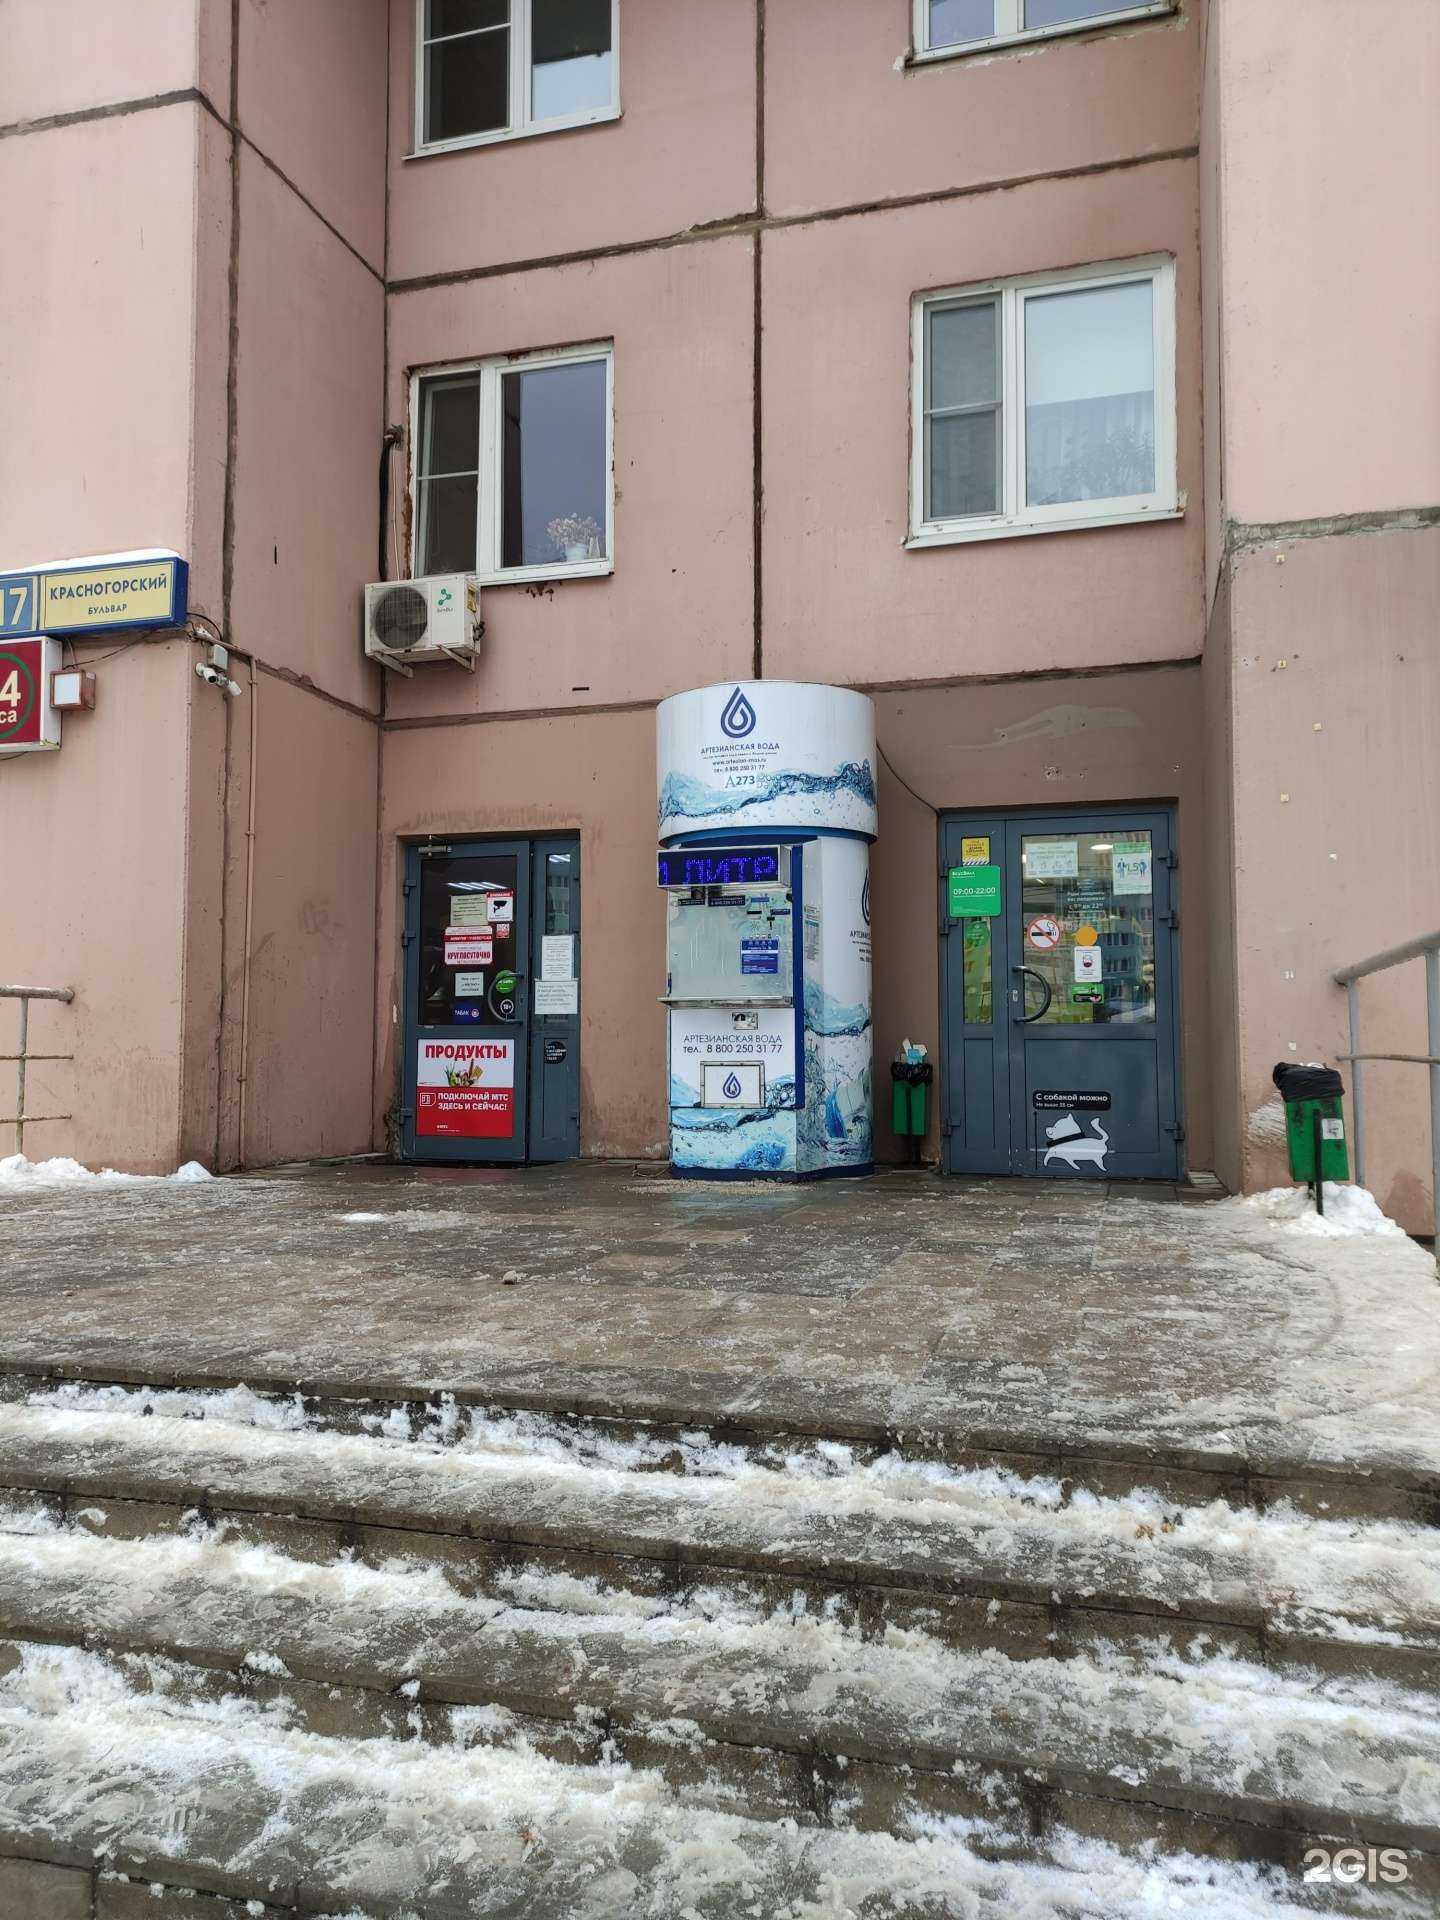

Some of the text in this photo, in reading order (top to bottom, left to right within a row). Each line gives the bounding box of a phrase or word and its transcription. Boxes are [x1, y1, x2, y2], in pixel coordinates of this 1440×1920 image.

[50, 573, 167, 601] КРАСНОГОРСКИЙ
[88, 603, 128, 615] БУЛЬВАР
[700, 742, 780, 754] АРТЕЗИАНСКАЯ ВОДА
[447, 951, 491, 960] КРУГЛОСУТОЧНО
[683, 1034, 782, 1043] АРТЕЗИАНСКАЯ ВОДА
[425, 1044, 507, 1061] ПРОДУКТЫ
[706, 1044, 713, 1053] 8
[715, 1044, 733, 1053] 800
[736, 1044, 754, 1053] 250
[756, 1044, 767, 1053] 31
[770, 1044, 783, 1053] 77
[437, 1091, 490, 1102] ПОДКЛЮЧАЙ
[1043, 1093, 1078, 1101] собакой
[438, 1102, 463, 1111] ЗДЕСЬ
[472, 1101, 507, 1111] СЕЙЧАС!
